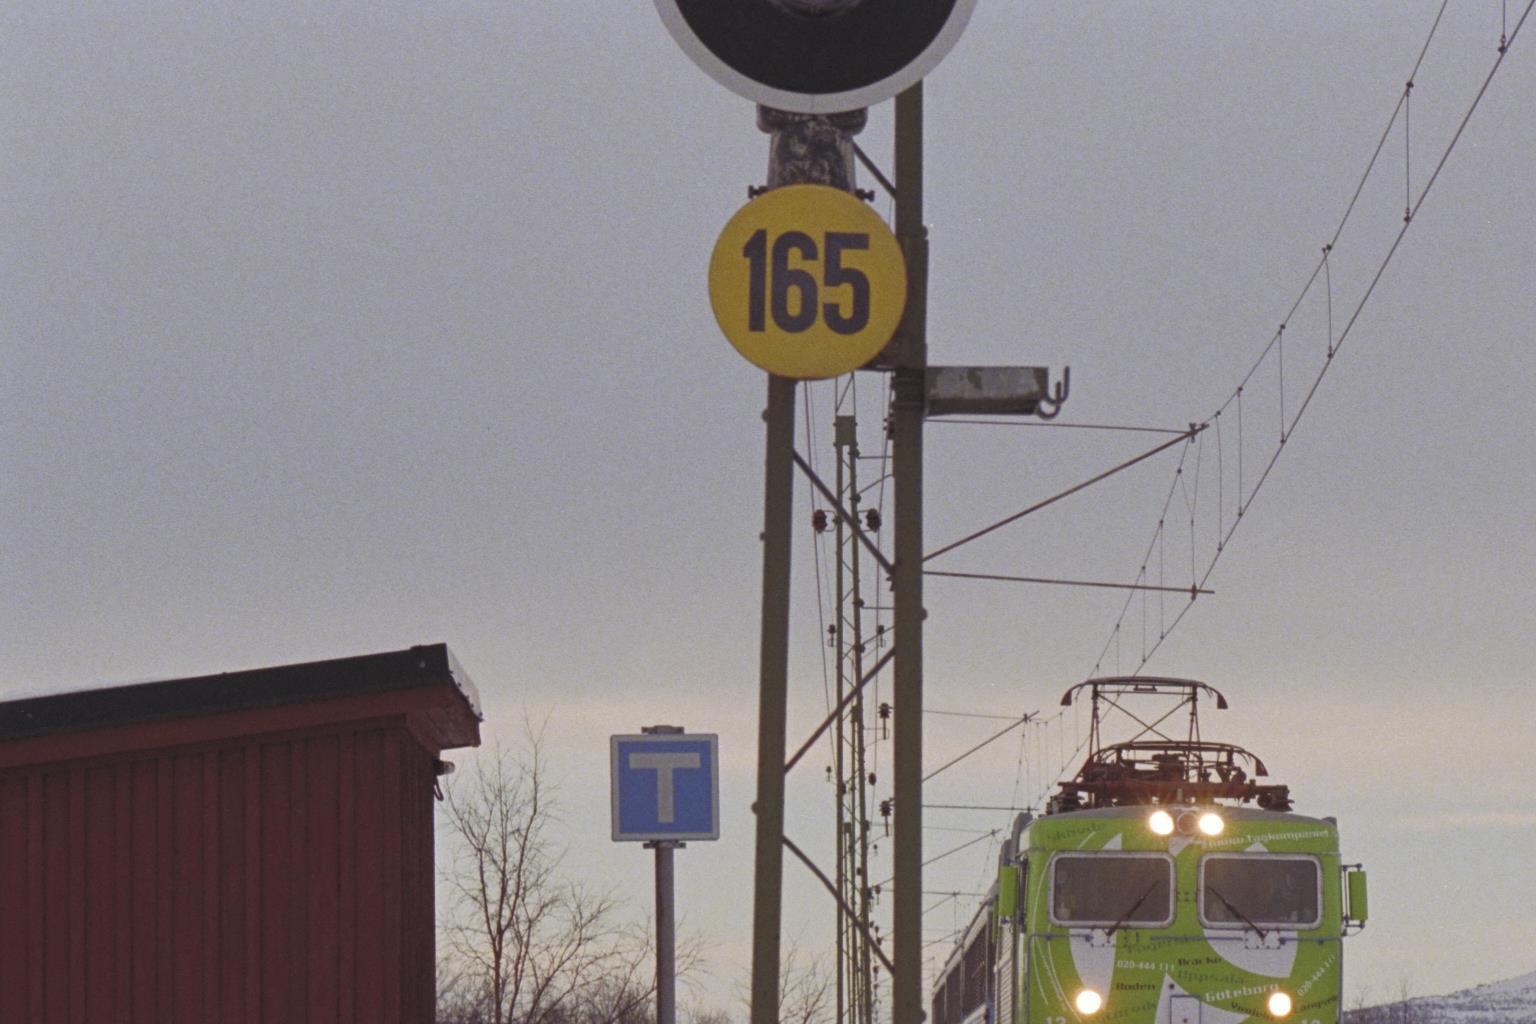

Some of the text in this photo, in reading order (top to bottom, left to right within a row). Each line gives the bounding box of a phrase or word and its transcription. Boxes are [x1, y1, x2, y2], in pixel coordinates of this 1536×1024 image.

[742, 228, 871, 336] 165
[629, 752, 701, 823] T
[1117, 960, 1156, 970] 020-444
